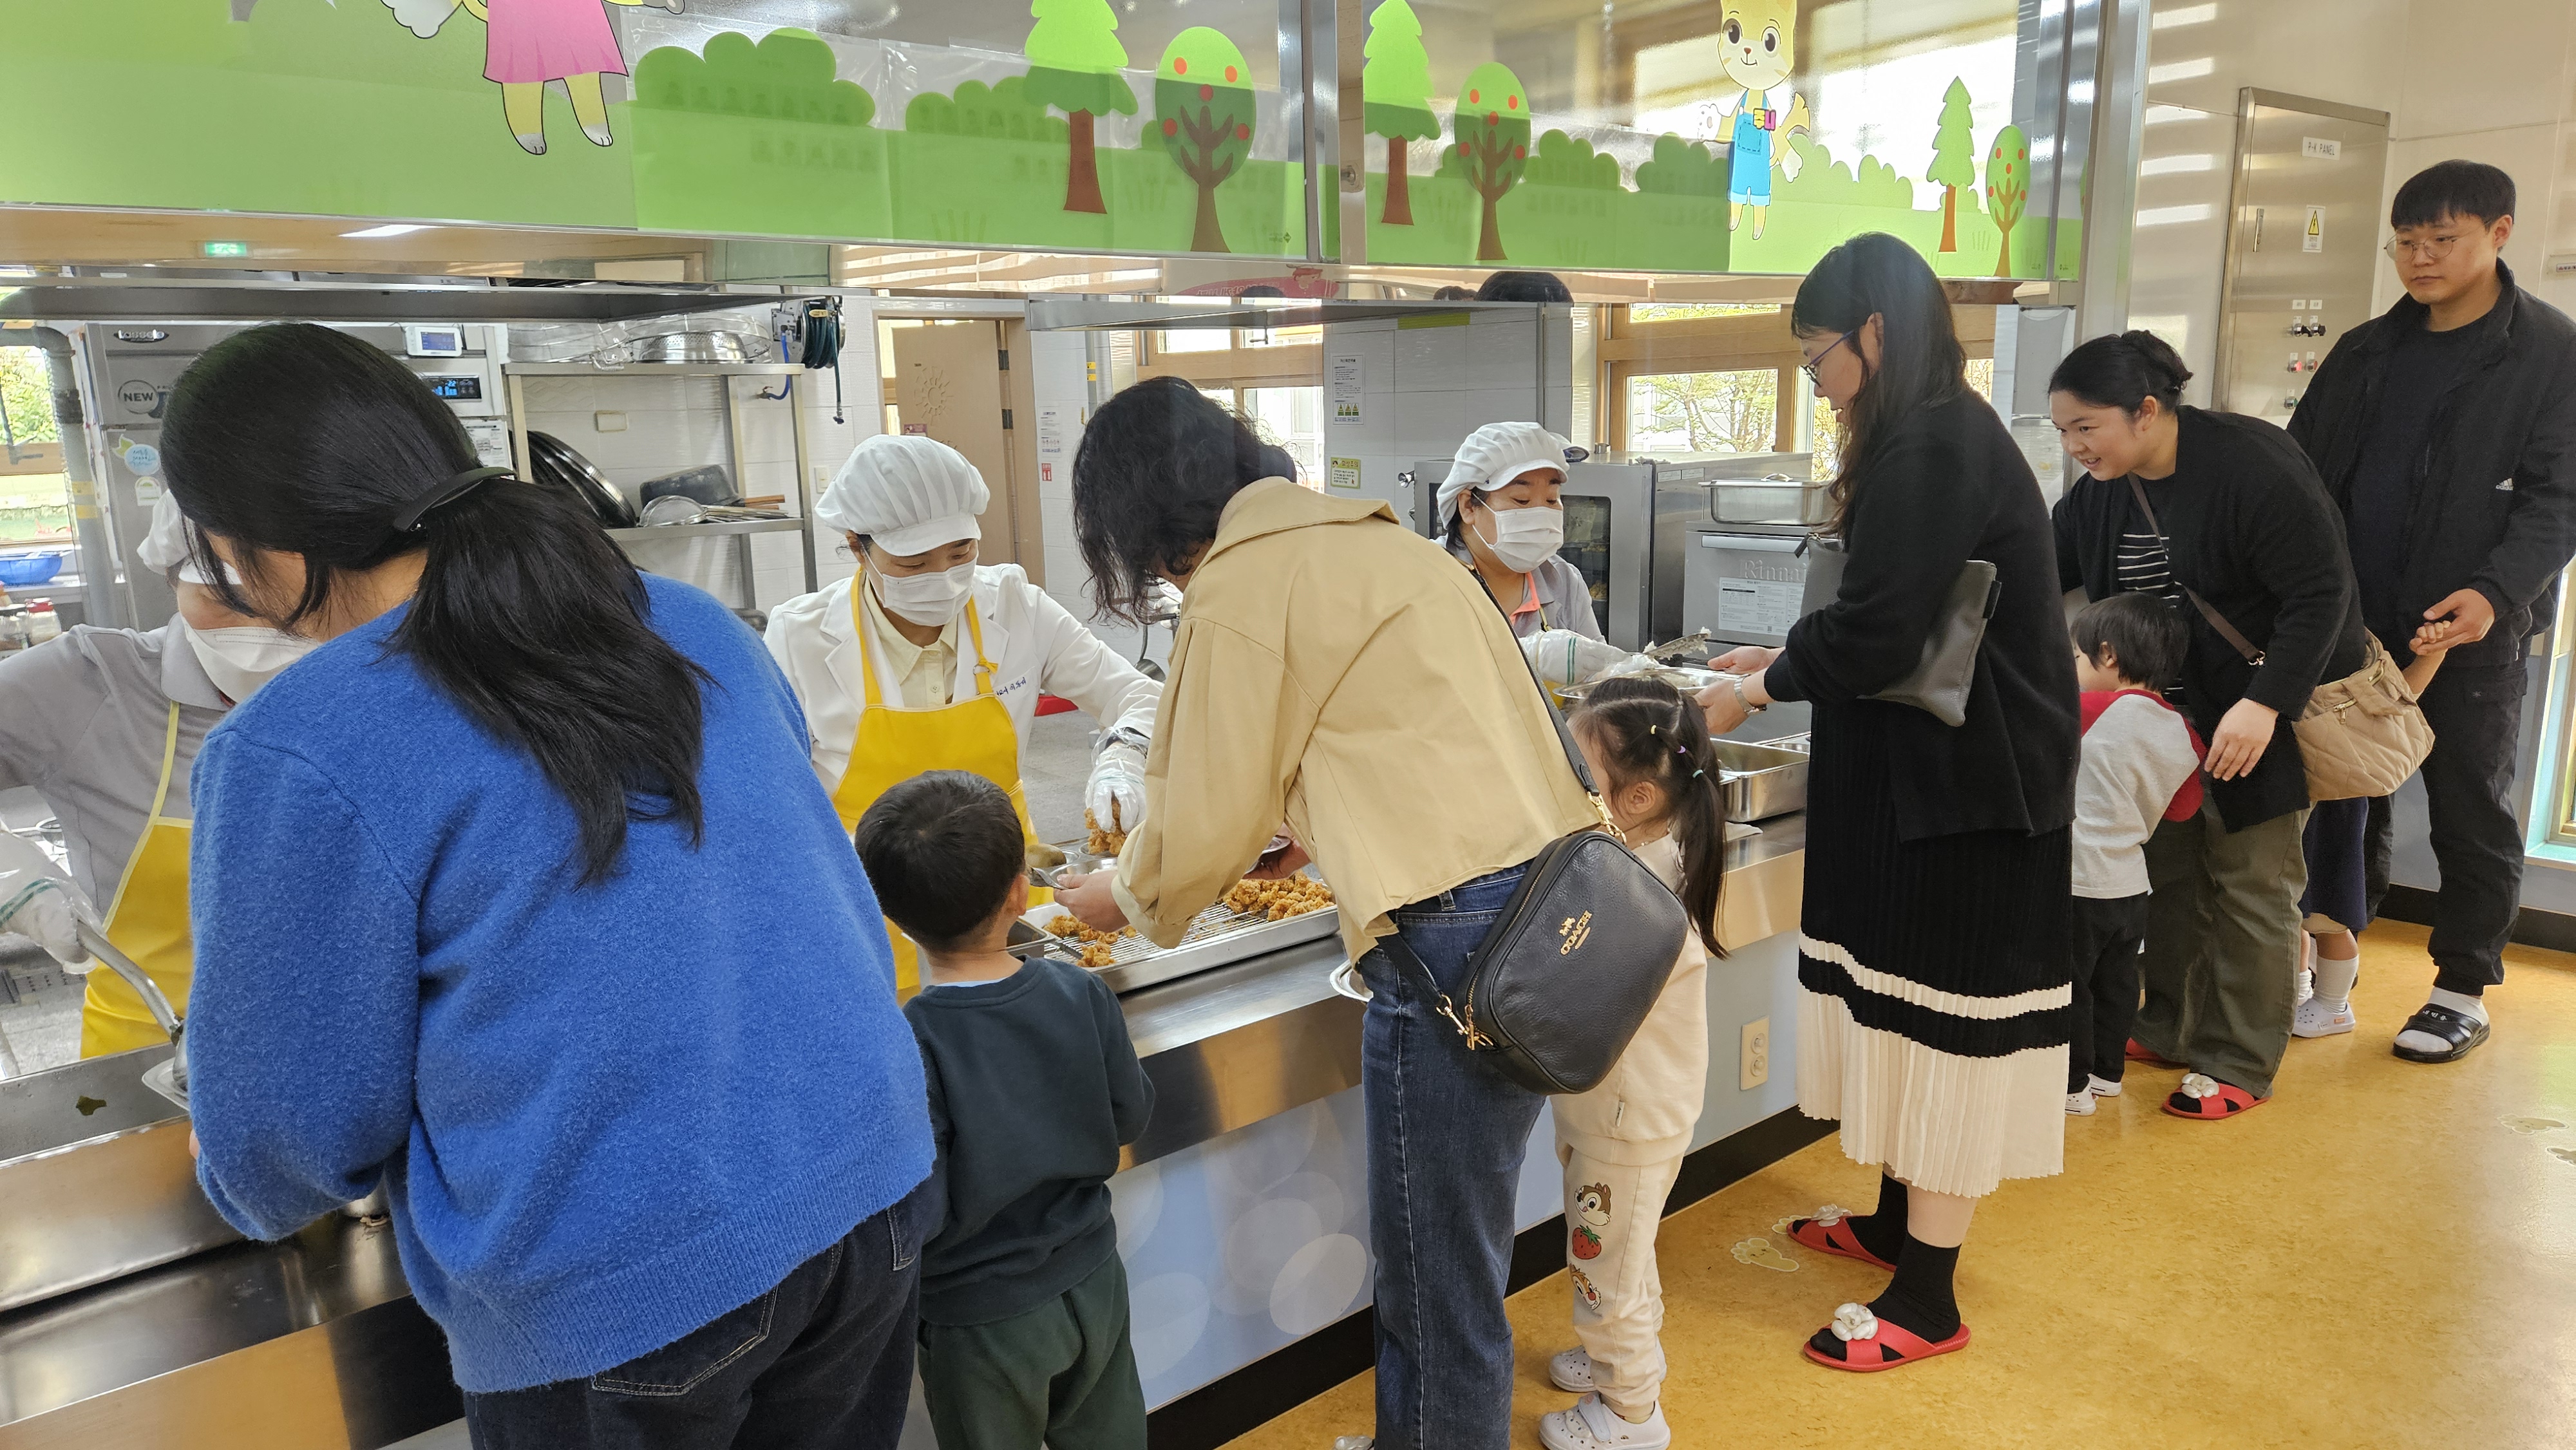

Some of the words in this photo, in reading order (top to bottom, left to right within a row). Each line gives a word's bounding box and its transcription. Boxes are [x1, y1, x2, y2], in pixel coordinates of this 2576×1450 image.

[2308, 142, 2317, 153] P-K
[2320, 144, 2334, 155] PANEL
[123, 392, 153, 401] NEW
[1739, 560, 1807, 583] Rinnai
[1560, 910, 1593, 956] COACH
